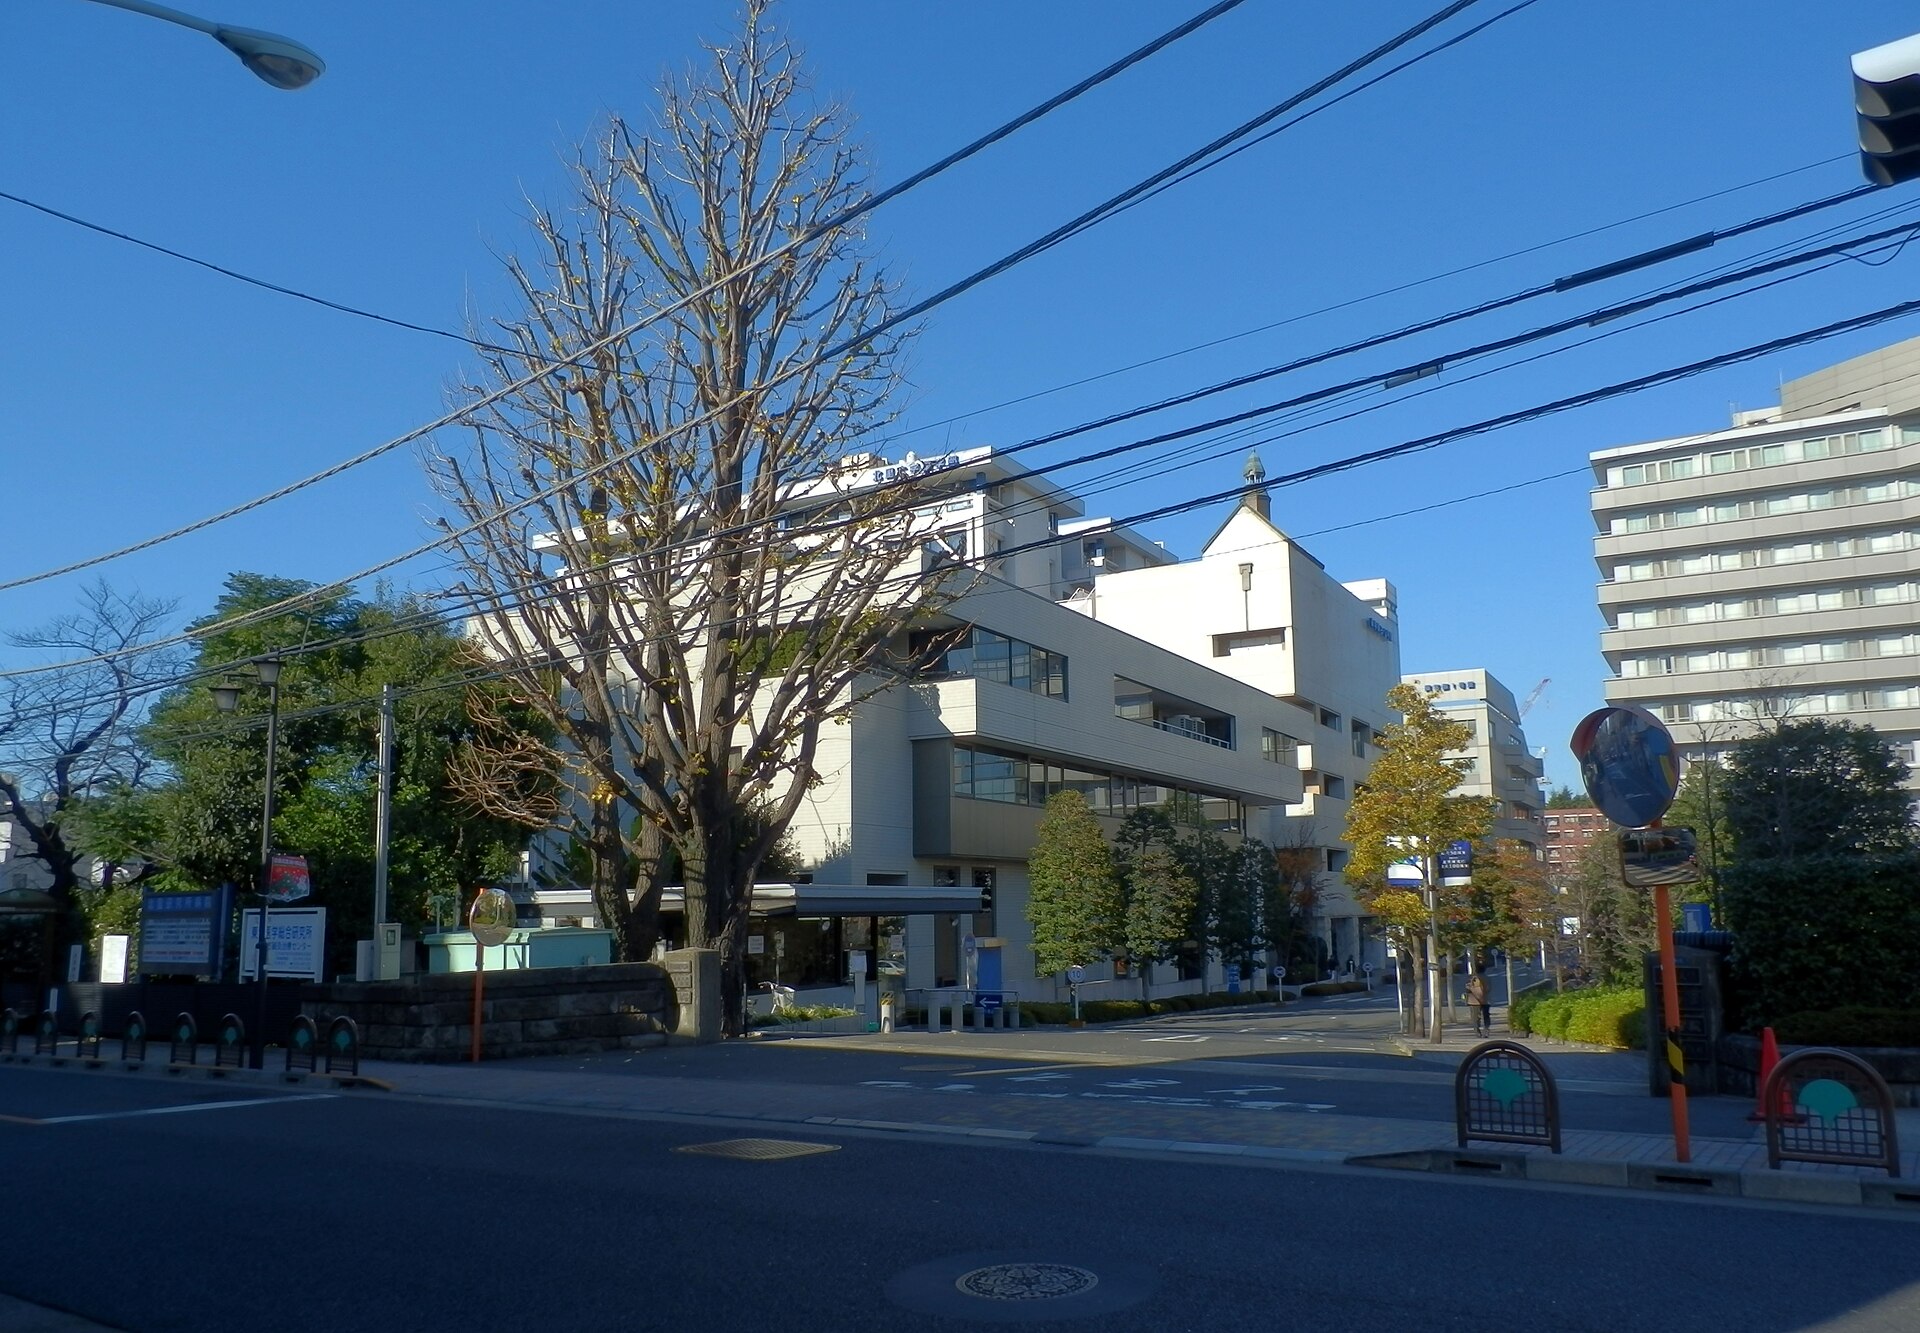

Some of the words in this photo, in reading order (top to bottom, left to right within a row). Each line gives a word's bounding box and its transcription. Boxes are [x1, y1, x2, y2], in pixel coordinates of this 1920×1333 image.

[252, 925, 312, 940] 東医学総合研究所
